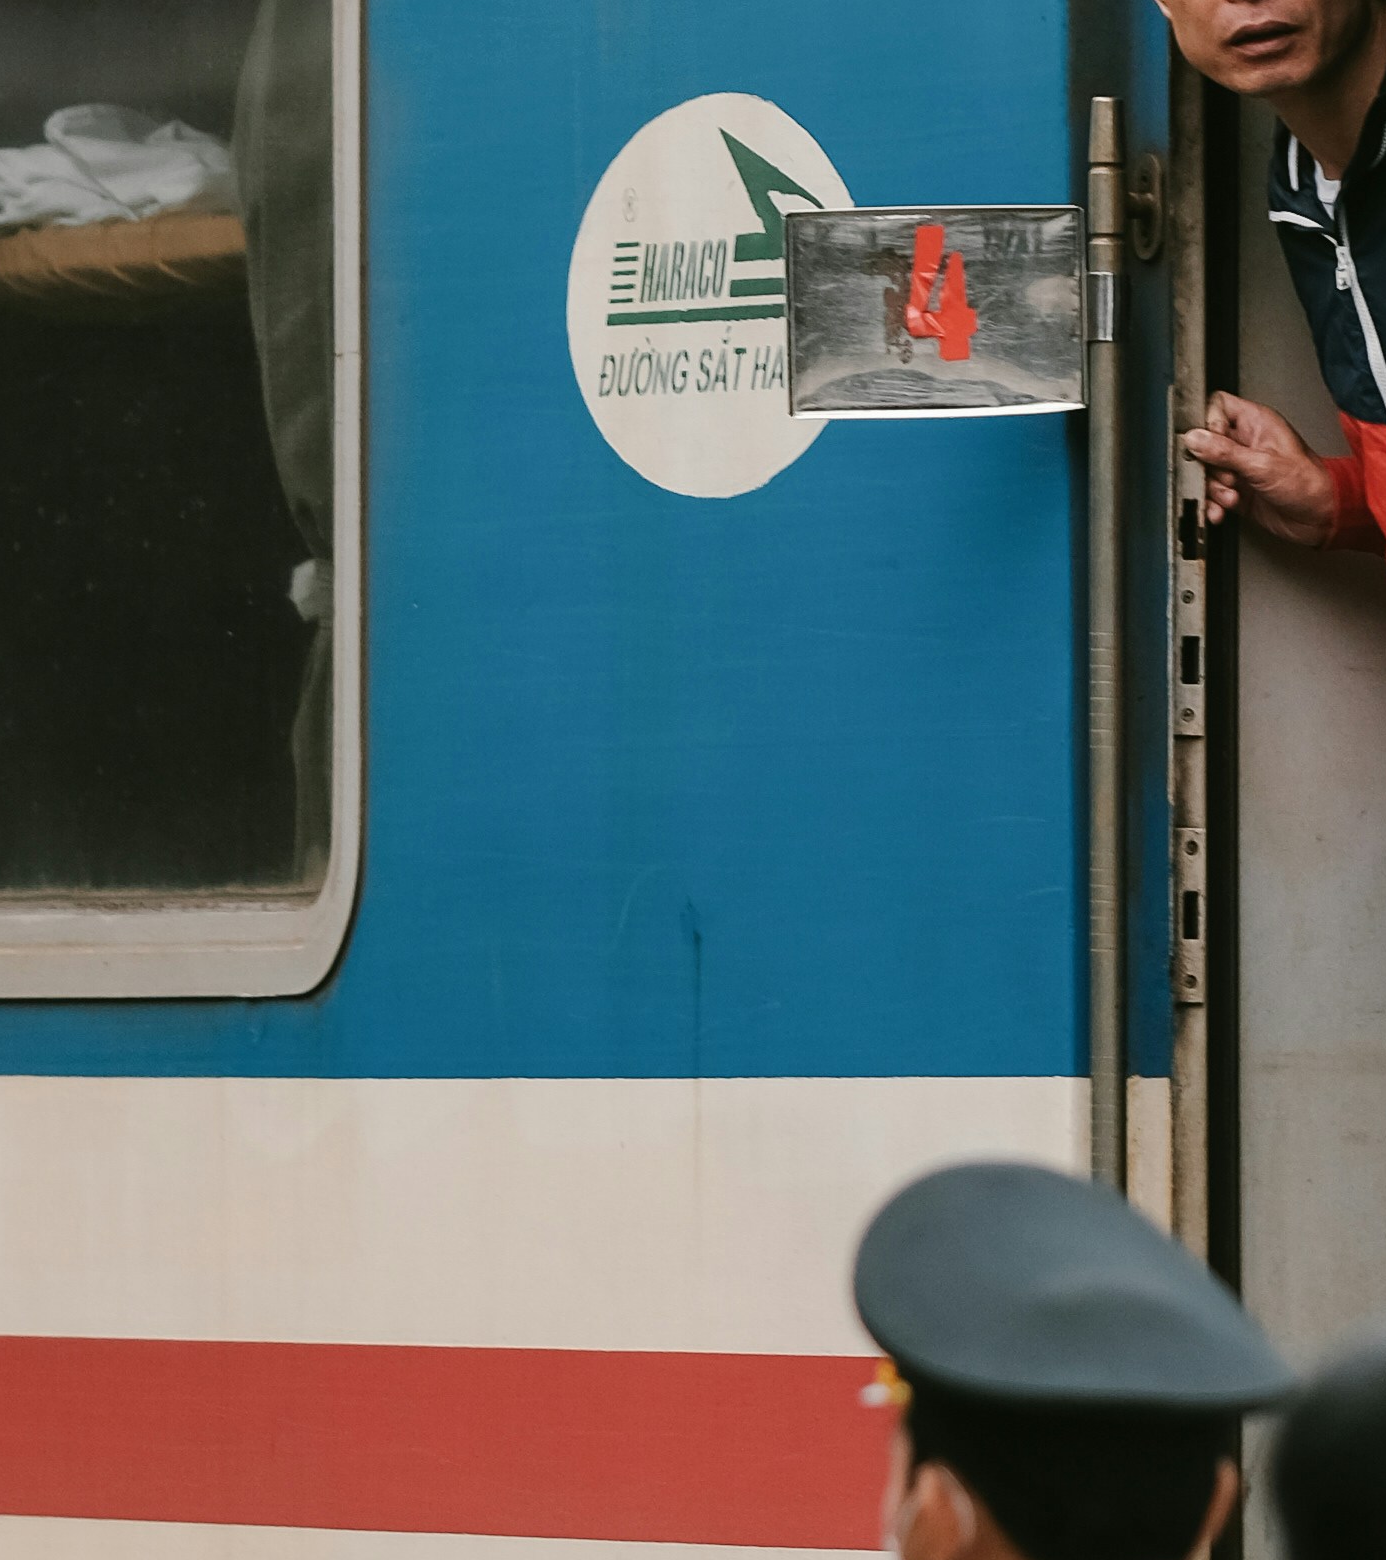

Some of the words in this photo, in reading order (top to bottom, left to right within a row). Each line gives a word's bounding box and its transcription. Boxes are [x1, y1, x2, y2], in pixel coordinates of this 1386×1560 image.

[640, 239, 727, 303] HARACO
[906, 225, 978, 361] 4
[599, 337, 689, 397] ĐƯỜNG
